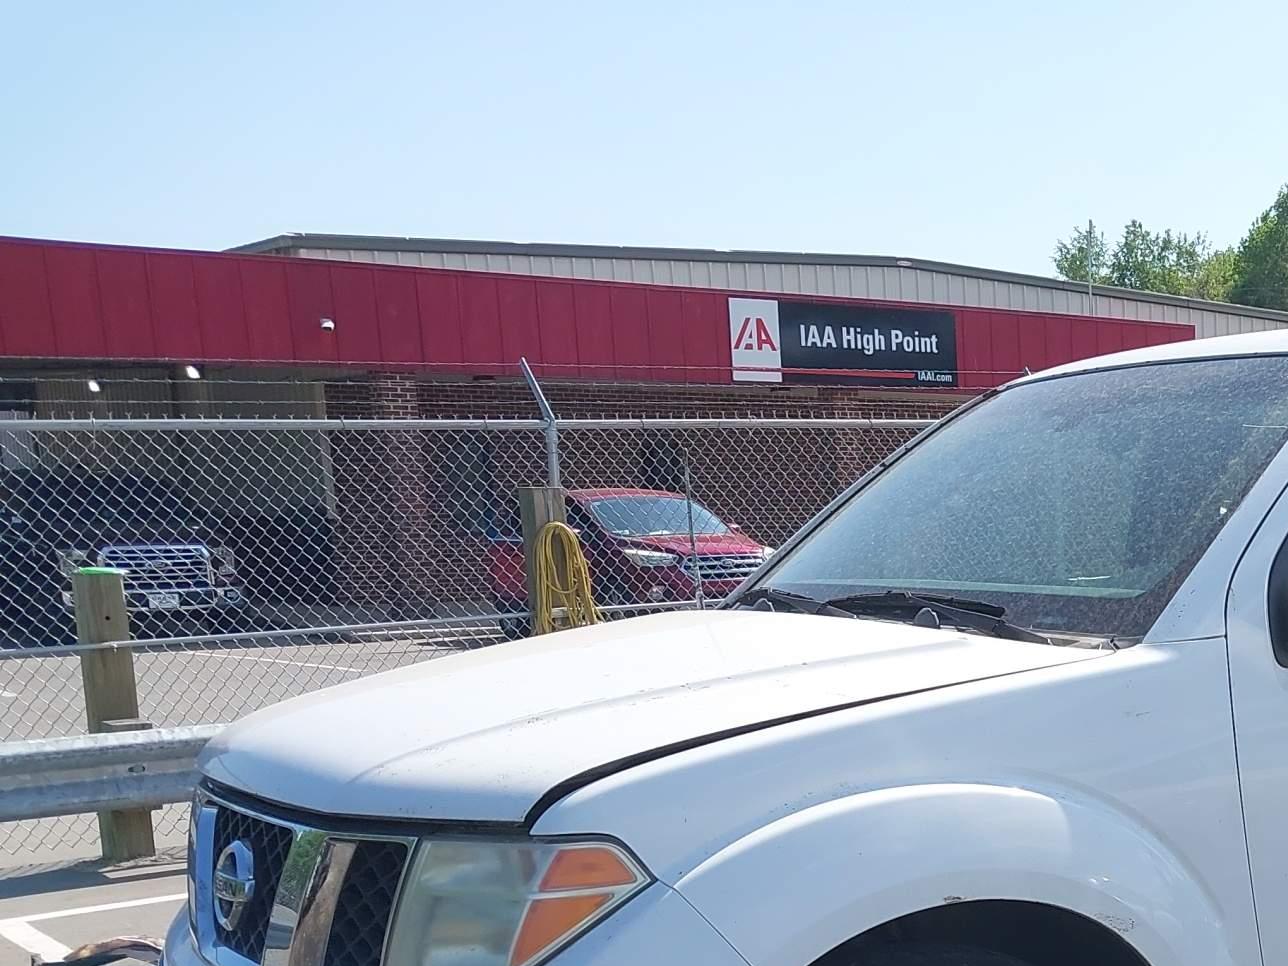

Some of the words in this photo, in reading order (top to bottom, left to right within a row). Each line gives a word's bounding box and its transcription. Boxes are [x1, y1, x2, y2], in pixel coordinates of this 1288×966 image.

[799, 324, 838, 348] IAA
[842, 326, 886, 355] High
[890, 329, 939, 354] Point
[917, 370, 953, 383] IAAI.com
